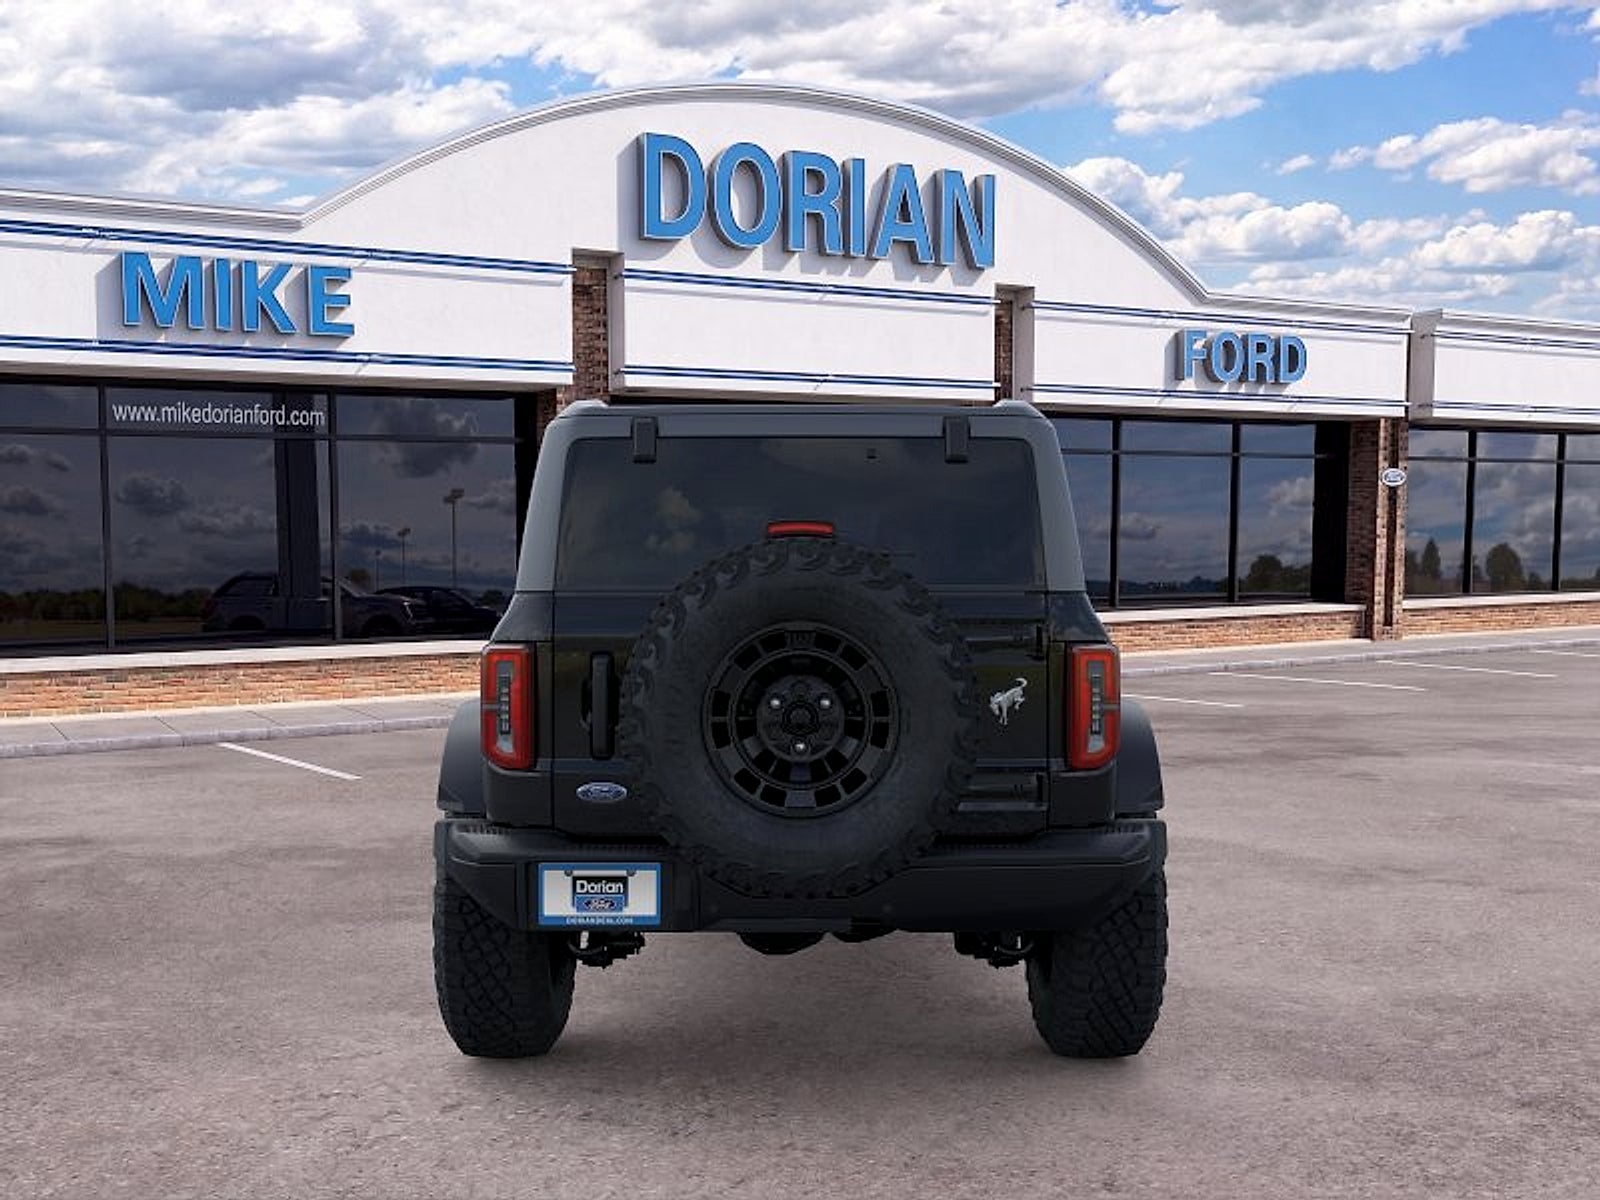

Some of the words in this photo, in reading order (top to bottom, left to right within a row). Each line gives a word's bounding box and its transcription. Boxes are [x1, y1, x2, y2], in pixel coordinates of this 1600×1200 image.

[638, 132, 995, 269] DORIAN
[121, 251, 355, 336] MIKE
[1176, 328, 1307, 383] FORD
[112, 402, 326, 426] www.mikedorianford.com
[575, 880, 624, 894] Dorian
